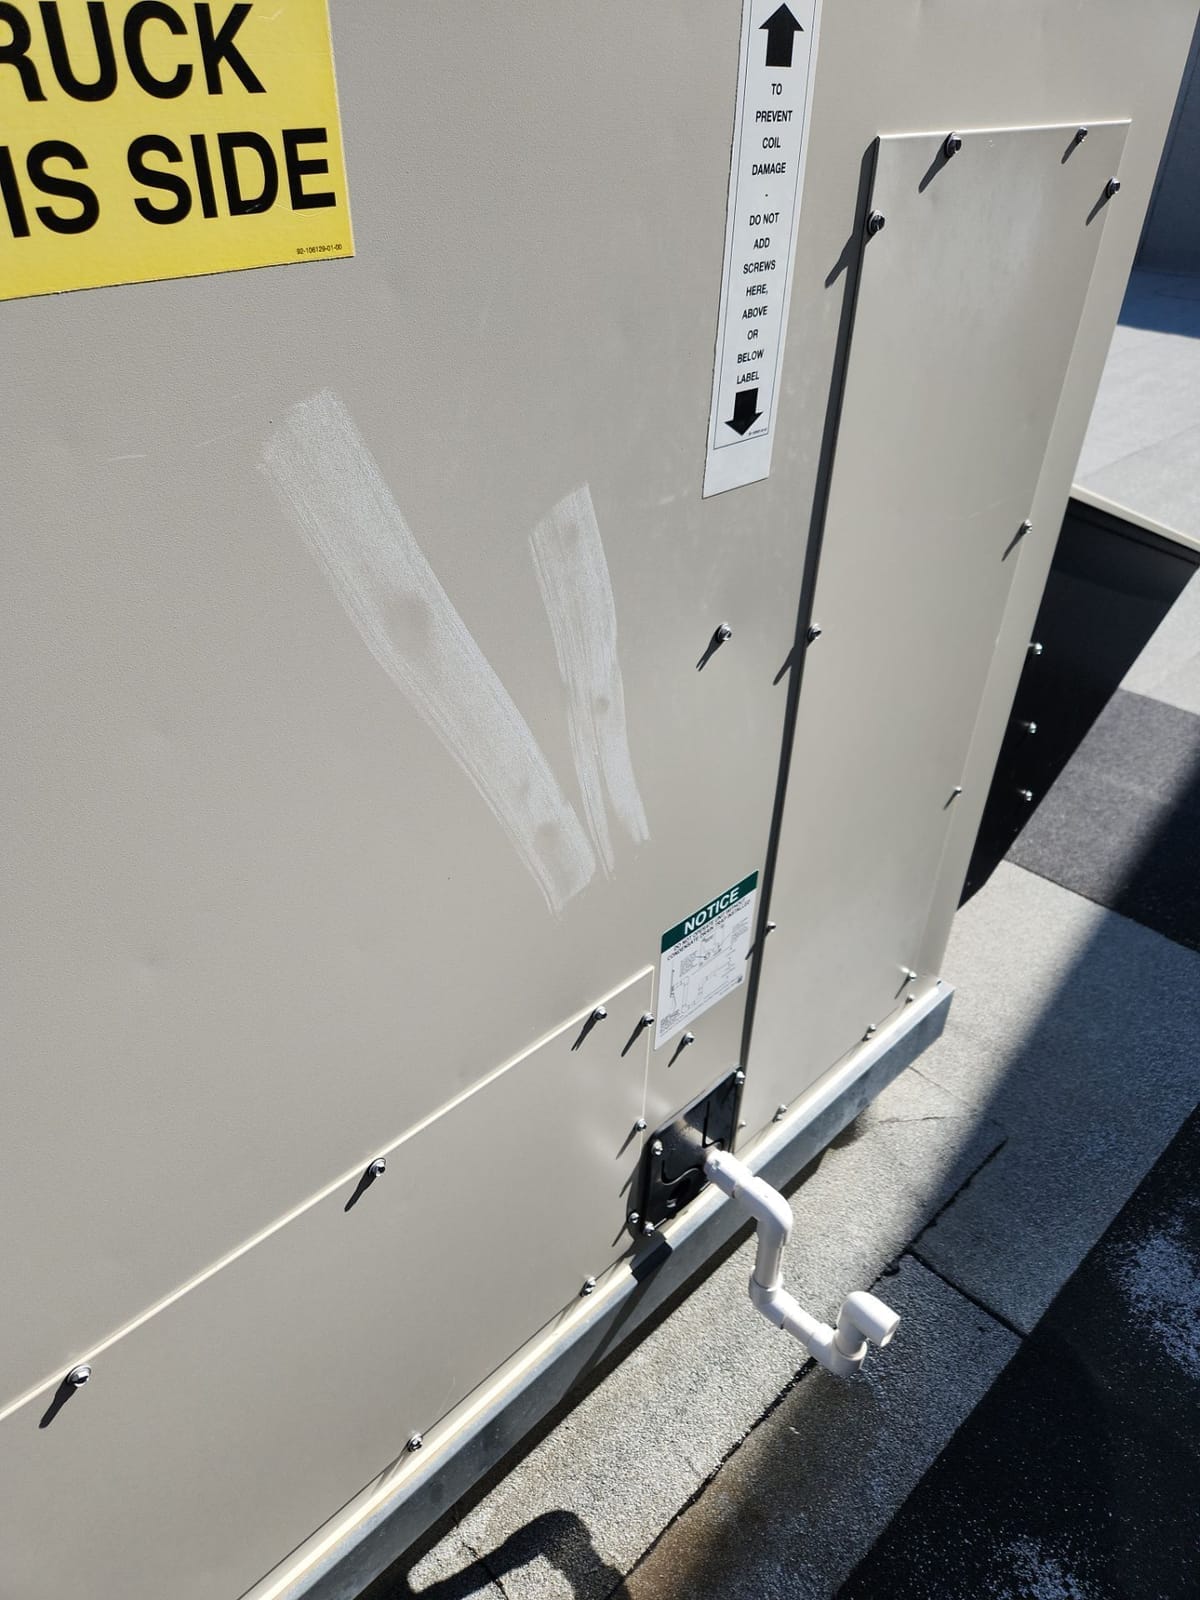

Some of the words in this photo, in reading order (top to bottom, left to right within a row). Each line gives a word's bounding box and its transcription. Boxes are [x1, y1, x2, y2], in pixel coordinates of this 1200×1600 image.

[771, 83, 783, 96] TO
[755, 110, 793, 123] PREVENT
[762, 137, 781, 149] COIL
[127, 127, 337, 225] SIDE
[752, 162, 787, 176] DAMAGE
[749, 214, 762, 226] DO
[762, 212, 780, 225] NOT
[753, 237, 771, 249] ADD
[743, 260, 776, 275] SCREWS
[745, 284, 768, 297] HERE,
[742, 306, 768, 320] ABOVE
[747, 329, 759, 341] OR
[737, 349, 764, 364] BELOW
[736, 371, 760, 385] LABEL
[684, 886, 740, 936] NOTICE
